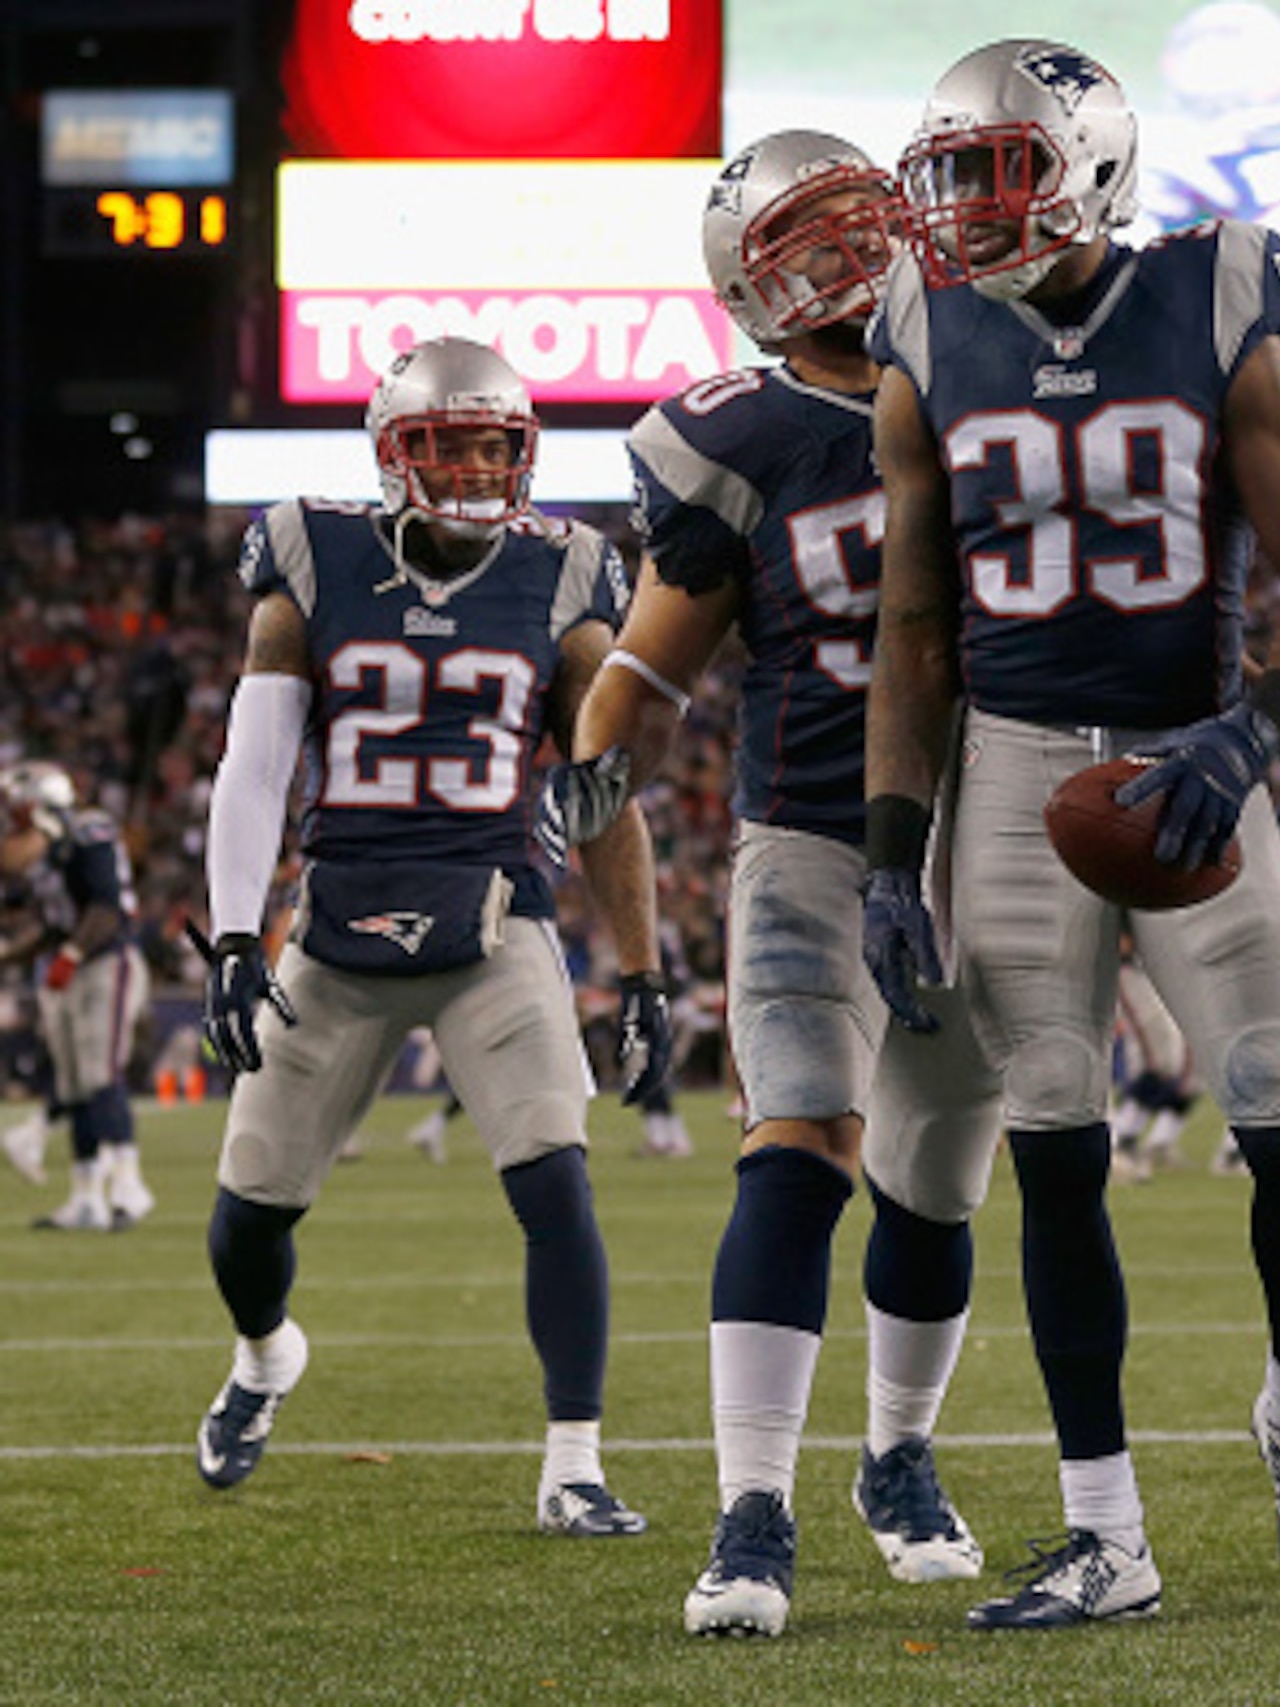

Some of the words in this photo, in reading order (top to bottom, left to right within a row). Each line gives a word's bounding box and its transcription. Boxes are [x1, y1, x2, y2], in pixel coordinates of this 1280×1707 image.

[297, 295, 722, 382] TOYOTA
[943, 395, 1210, 619] 39
[319, 639, 537, 814] 23
